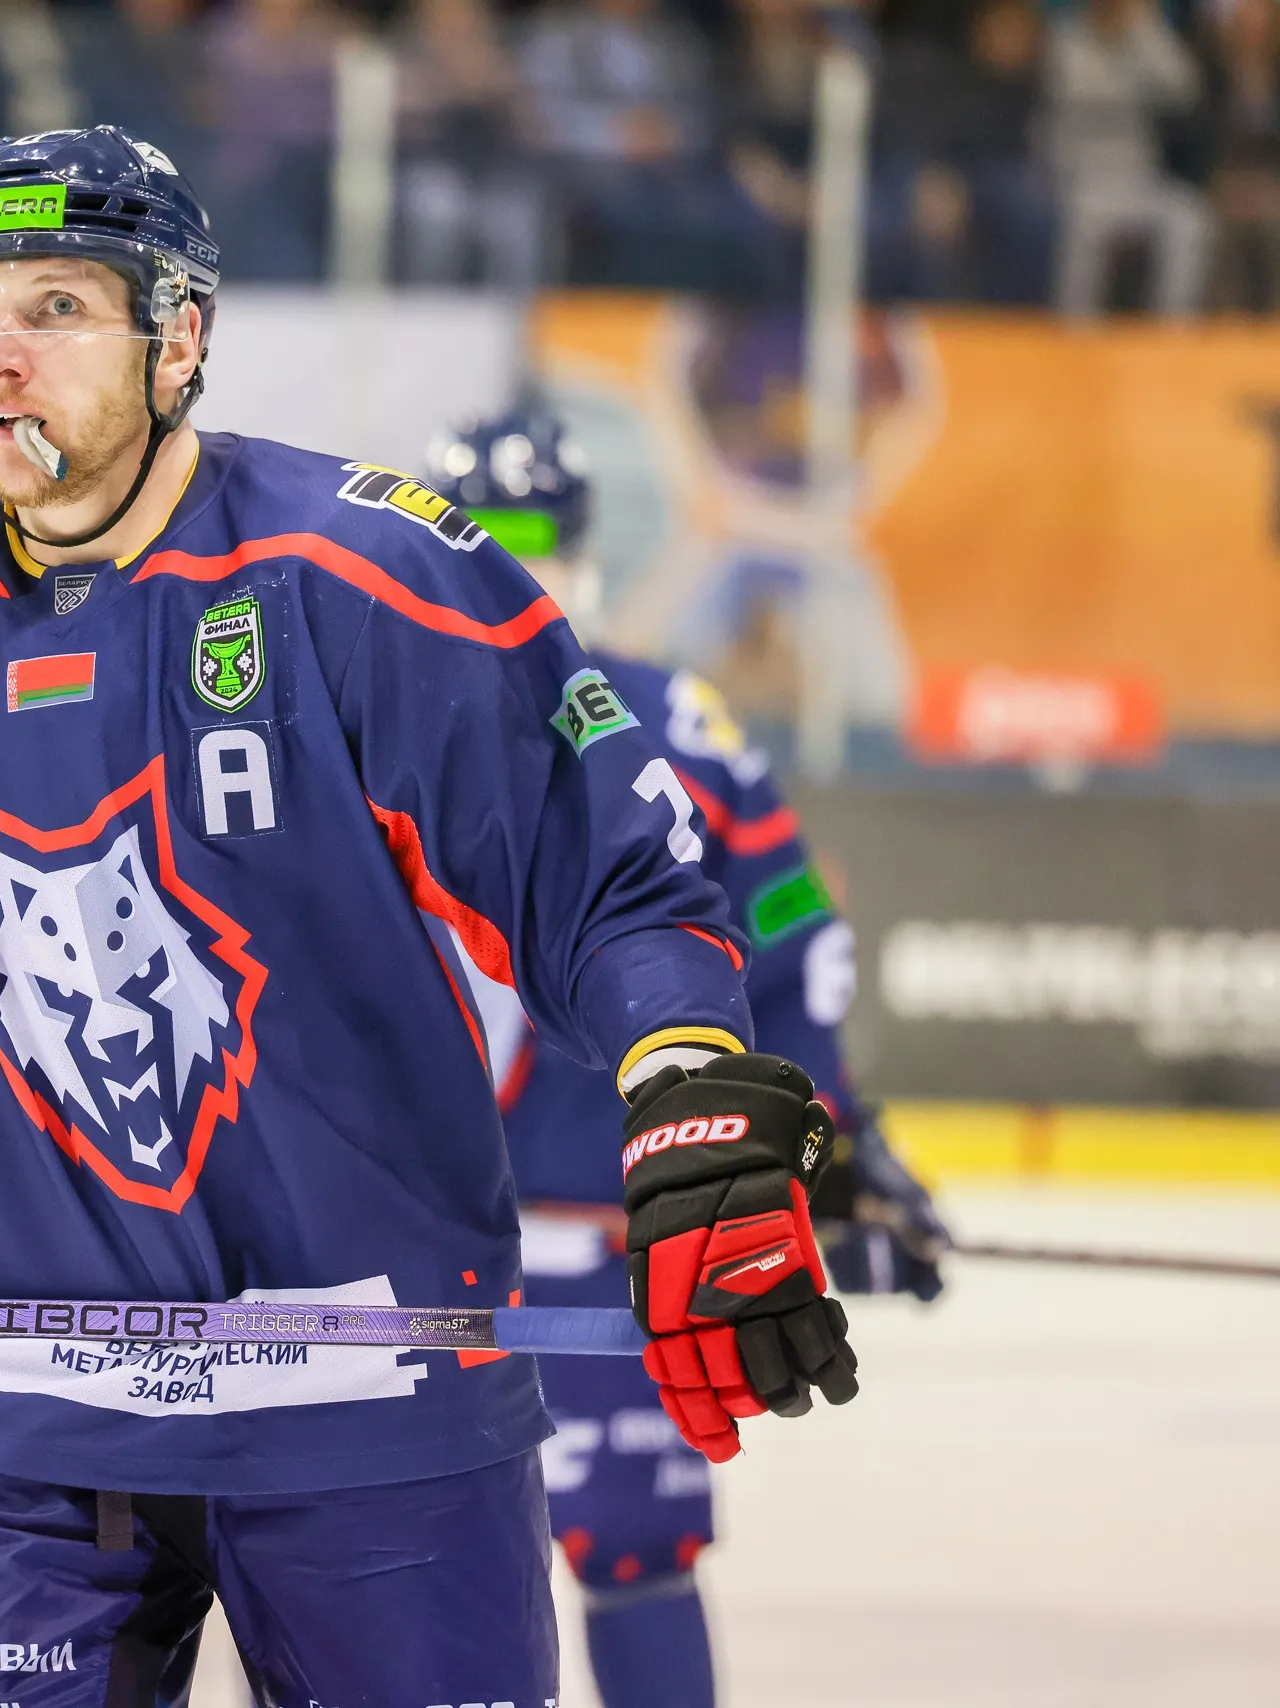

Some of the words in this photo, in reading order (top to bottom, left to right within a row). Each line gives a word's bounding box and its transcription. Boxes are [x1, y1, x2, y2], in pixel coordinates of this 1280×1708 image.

[186, 239, 218, 264] CCM
[204, 617, 251, 636] ФИНАЛ
[198, 729, 276, 836] A
[219, 1312, 320, 1332] TRIGGER
[322, 1315, 340, 1332] 8
[341, 1315, 367, 1326] PRO
